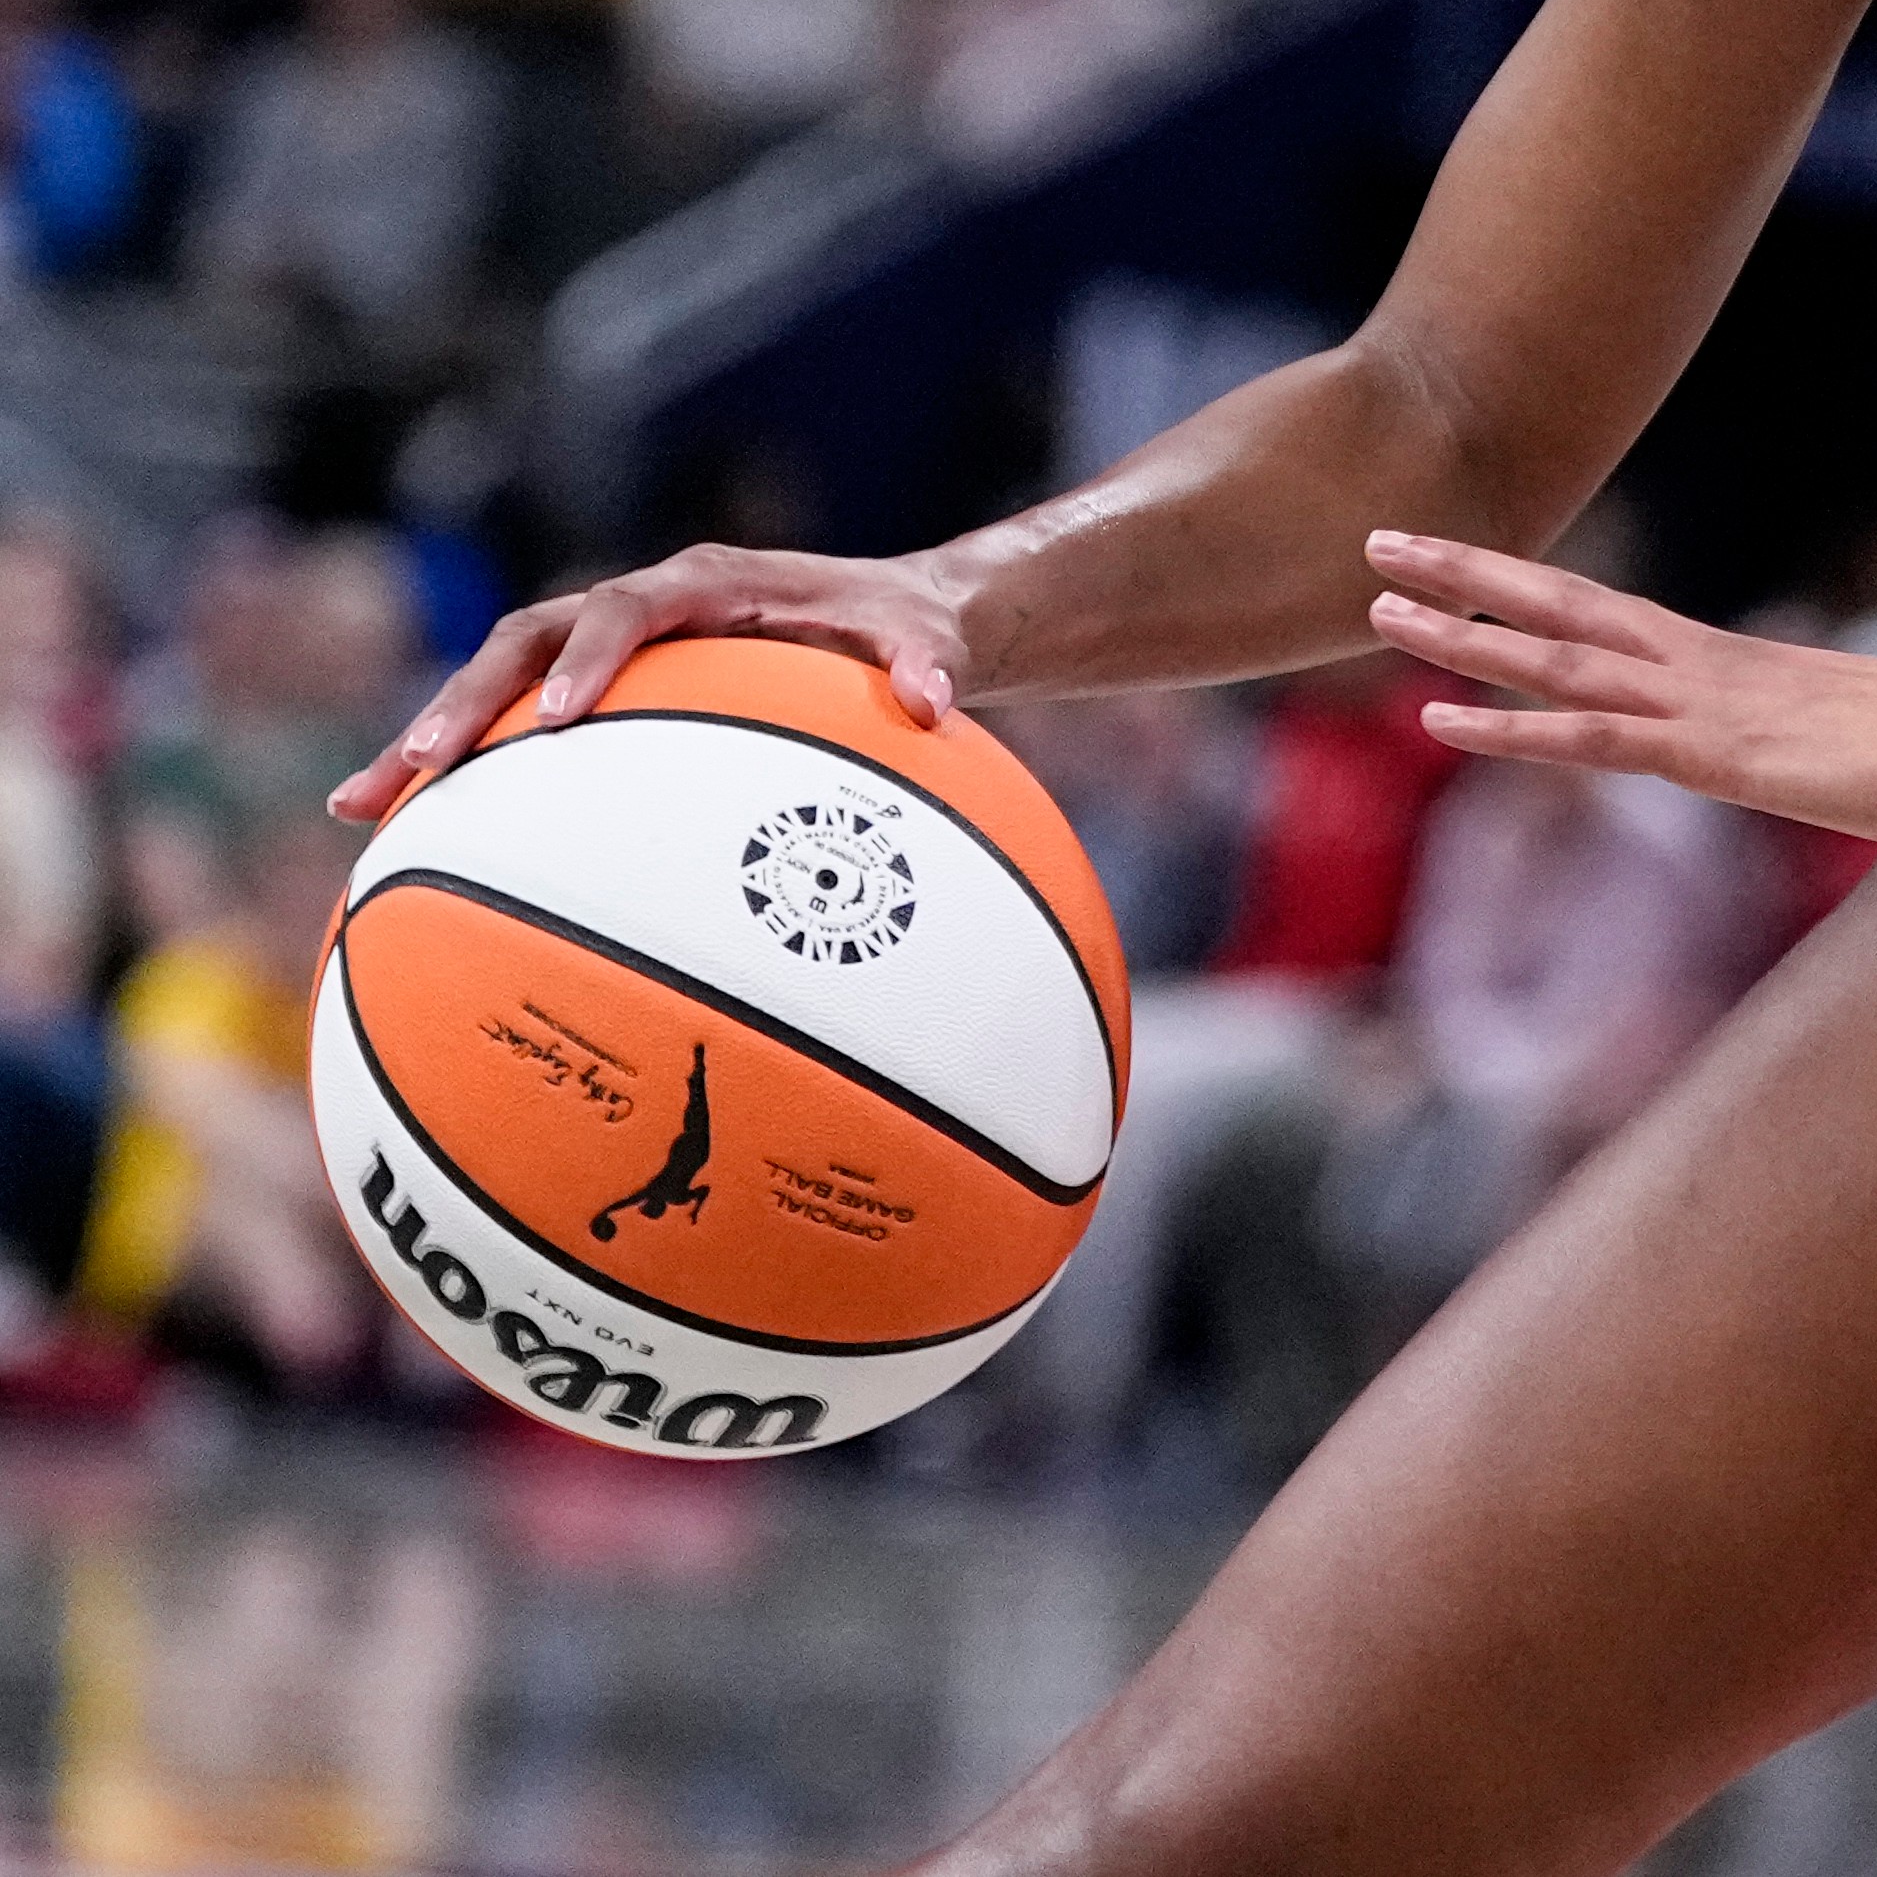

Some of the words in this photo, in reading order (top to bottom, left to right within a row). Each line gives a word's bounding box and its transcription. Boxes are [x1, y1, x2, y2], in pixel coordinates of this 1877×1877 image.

[764, 1159, 834, 1199] BALL
[770, 1190, 887, 1242] OFFICIAL
[837, 1189, 915, 1223] GAME
[359, 1140, 828, 1448] Wilson
[525, 1288, 583, 1326] NXT
[594, 1325, 655, 1357] EVO
